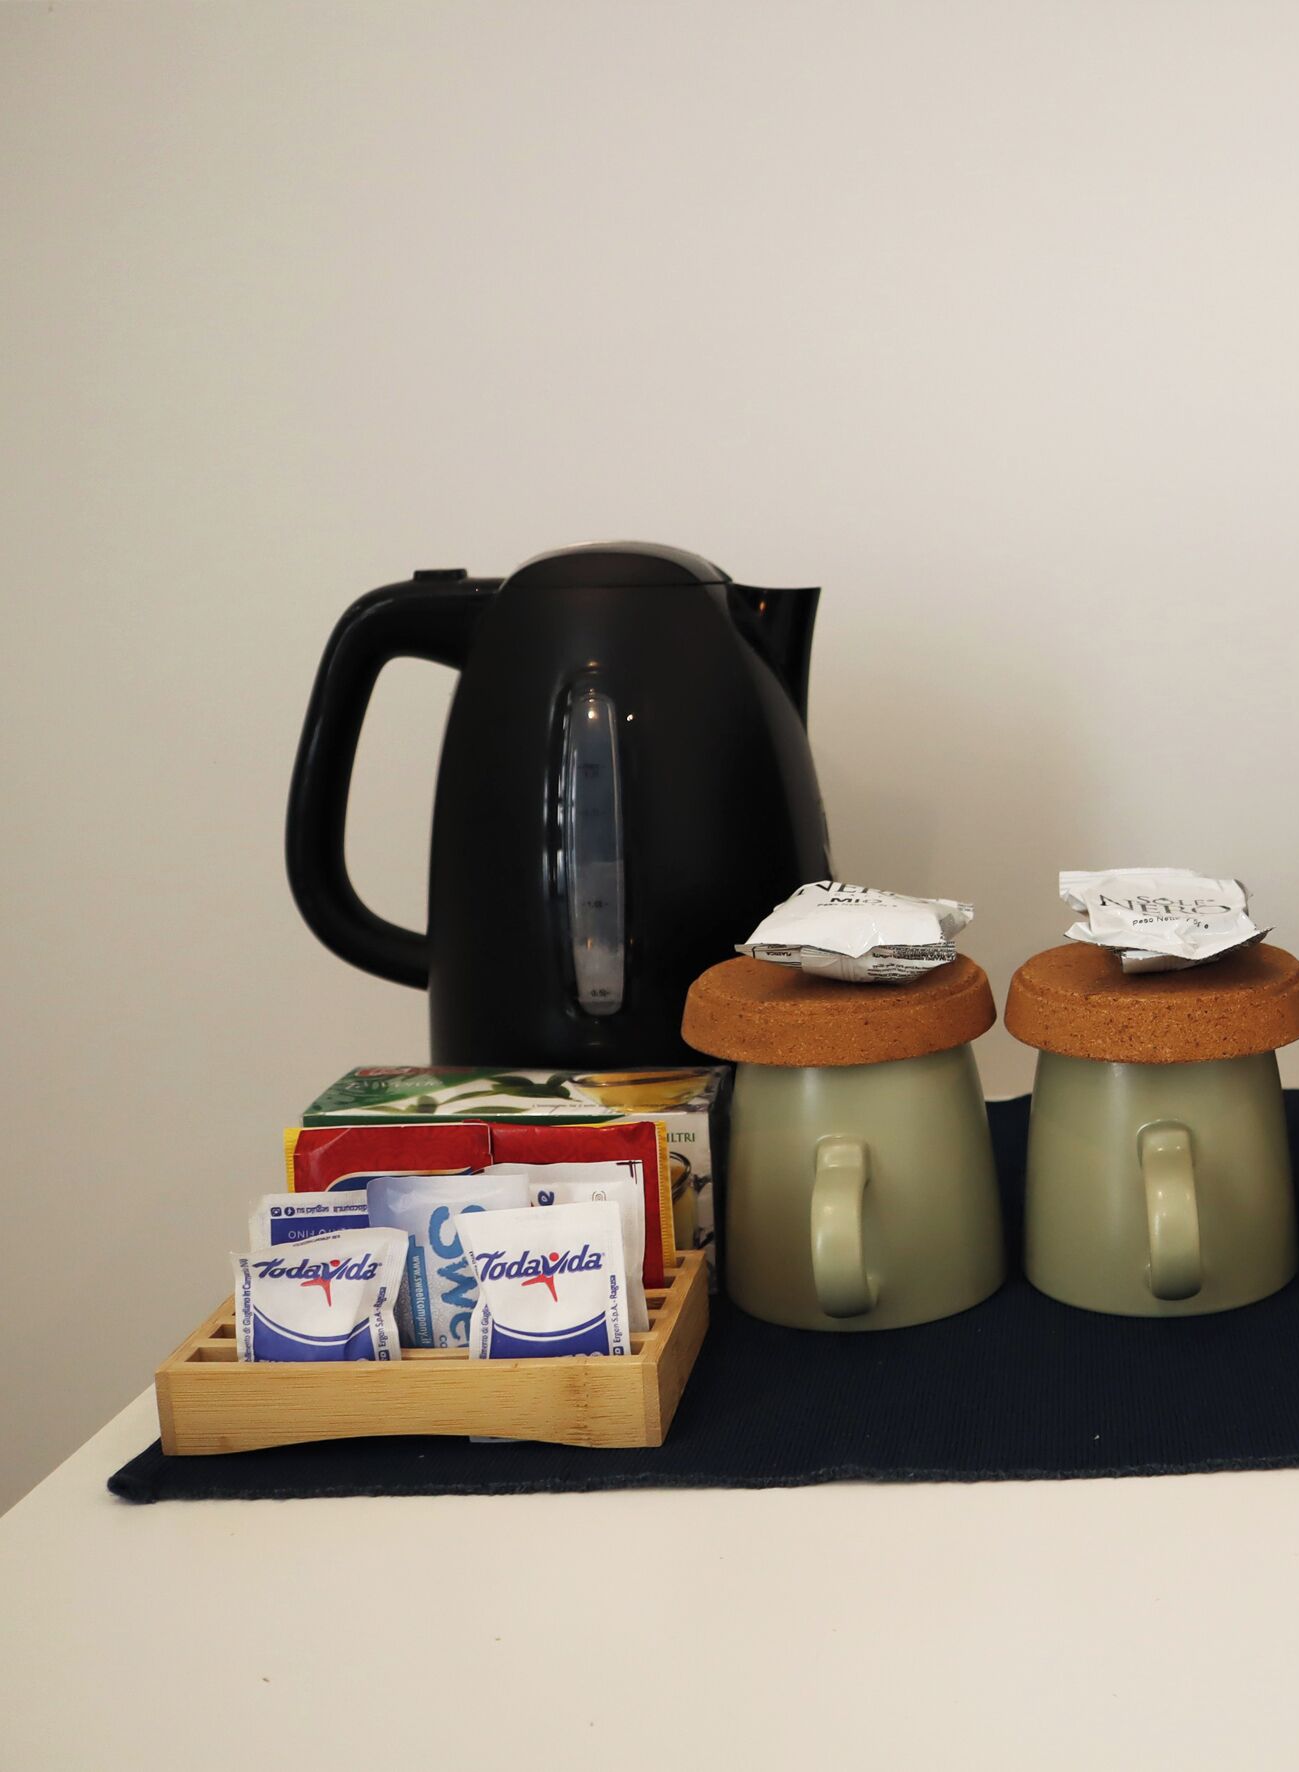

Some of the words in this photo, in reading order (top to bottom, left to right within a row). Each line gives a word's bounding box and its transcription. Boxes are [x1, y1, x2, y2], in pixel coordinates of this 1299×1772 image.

[666, 1132, 696, 1143] ILTRI
[411, 1255, 433, 1345] www.sweetcompany.it
[609, 1275, 619, 1300] Ragusa
